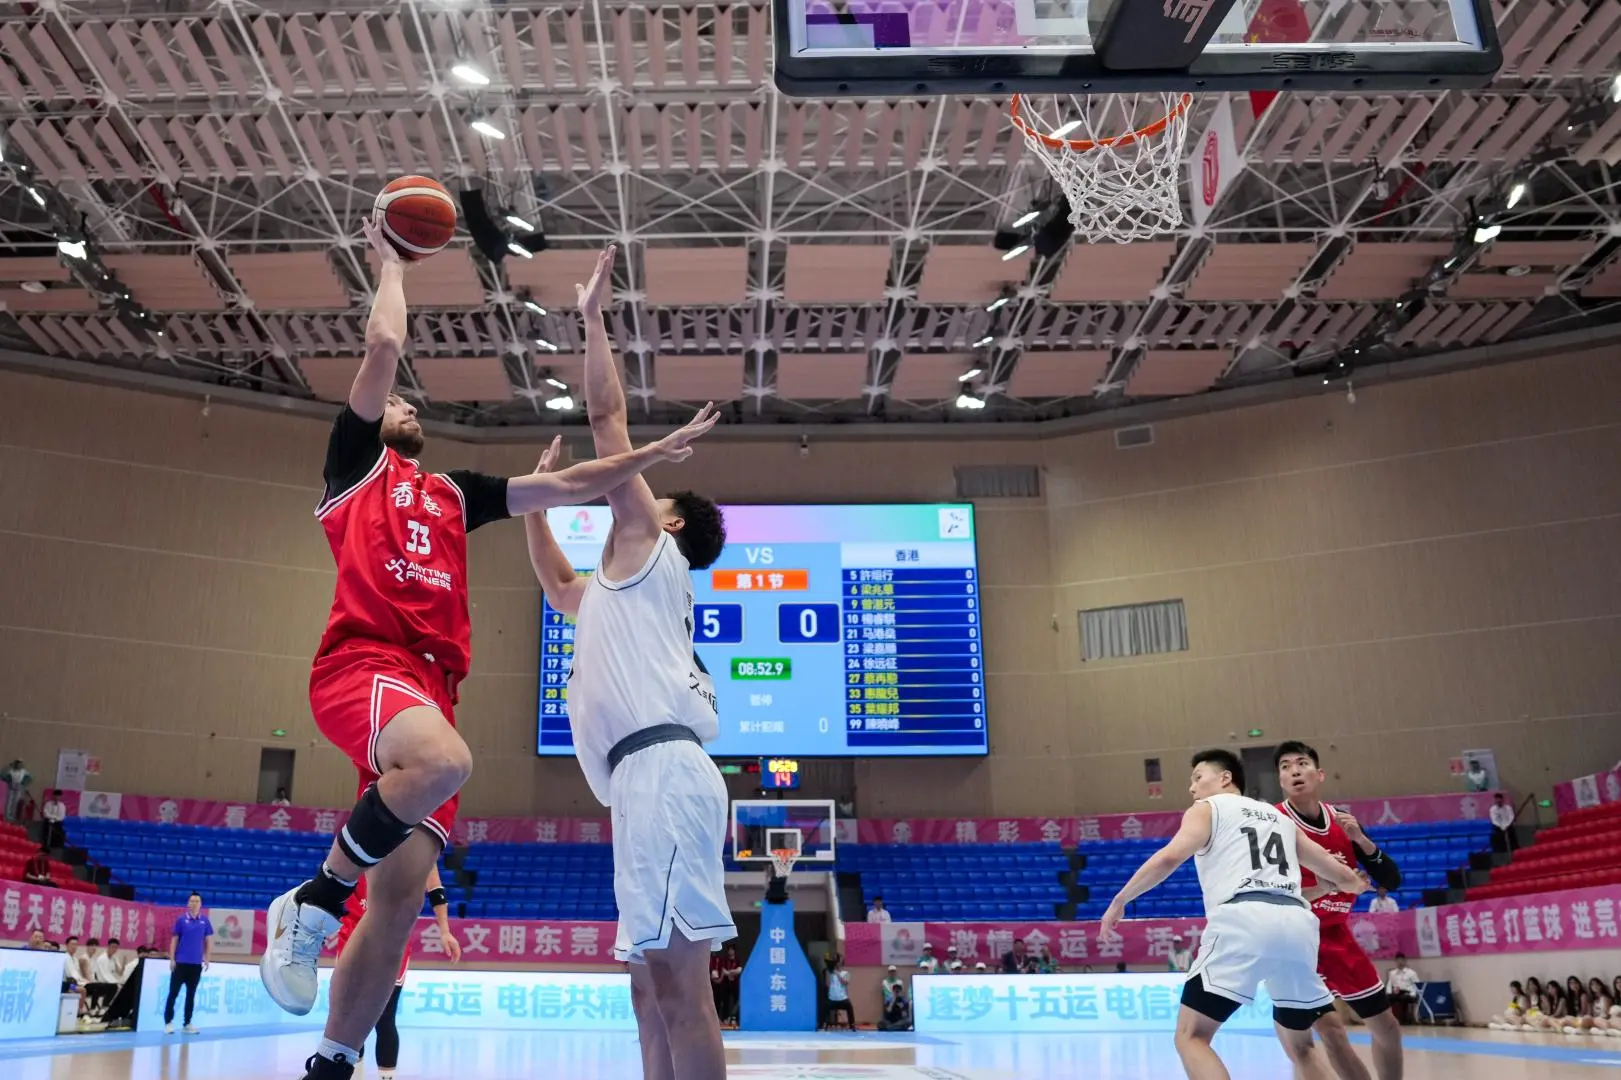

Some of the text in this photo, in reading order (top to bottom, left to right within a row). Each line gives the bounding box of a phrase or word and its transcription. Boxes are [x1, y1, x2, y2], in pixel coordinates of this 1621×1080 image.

[406, 520, 431, 555] 33
[745, 548, 774, 564] VS
[895, 549, 920, 561] 香港
[407, 562, 452, 582] ANYTIME
[850, 570, 858, 580] 5
[965, 570, 973, 580] 0
[406, 571, 452, 592] FITNESS
[851, 585, 858, 595] 6
[966, 584, 974, 594] 0
[851, 599, 858, 610] 9
[967, 598, 974, 609] 0
[553, 614, 560, 624] 9
[702, 609, 720, 638] 5
[800, 609, 818, 638] 0
[847, 614, 859, 624] 10
[968, 613, 976, 624] 0
[548, 629, 560, 640] 12
[847, 629, 858, 639] 21
[969, 628, 976, 638] 0
[848, 644, 860, 654] 23
[970, 643, 977, 653] 0
[547, 659, 558, 669] 17
[738, 662, 784, 676] 08:52.9
[971, 658, 978, 668] 0
[546, 674, 558, 684] 19
[848, 674, 860, 684] 27
[972, 673, 979, 683] 0
[545, 688, 558, 699] 20
[972, 688, 980, 698] 0
[544, 704, 557, 714] 22
[973, 703, 981, 713] 0
[819, 717, 828, 733] 0
[850, 719, 862, 730] 99
[974, 718, 982, 728] 0
[774, 772, 792, 786] 14
[955, 815, 1144, 844] 精彩全运会
[1240, 826, 1290, 876] 14
[2, 887, 140, 943] 每天绽放新精彩
[1571, 898, 1621, 938] 进莞
[463, 924, 617, 956] 文明东莞
[1103, 985, 1182, 1021] 电信
